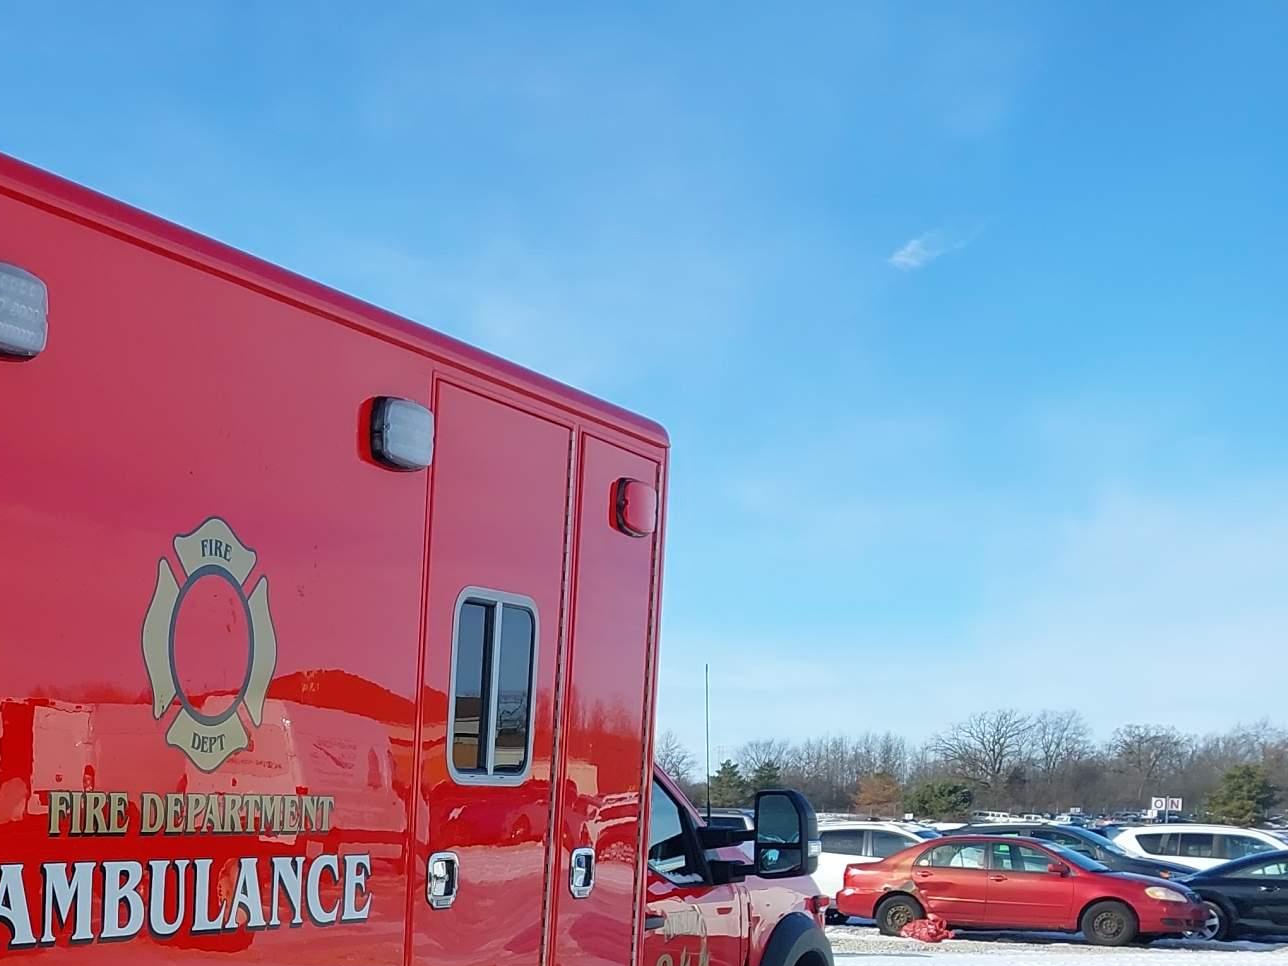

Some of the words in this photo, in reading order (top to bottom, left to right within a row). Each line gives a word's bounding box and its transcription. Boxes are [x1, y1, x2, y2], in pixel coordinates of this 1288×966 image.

[200, 539, 233, 563] FIRE
[190, 731, 226, 754] DEPT
[48, 791, 129, 836] FIRE
[140, 792, 335, 836] DEPARTMENT
